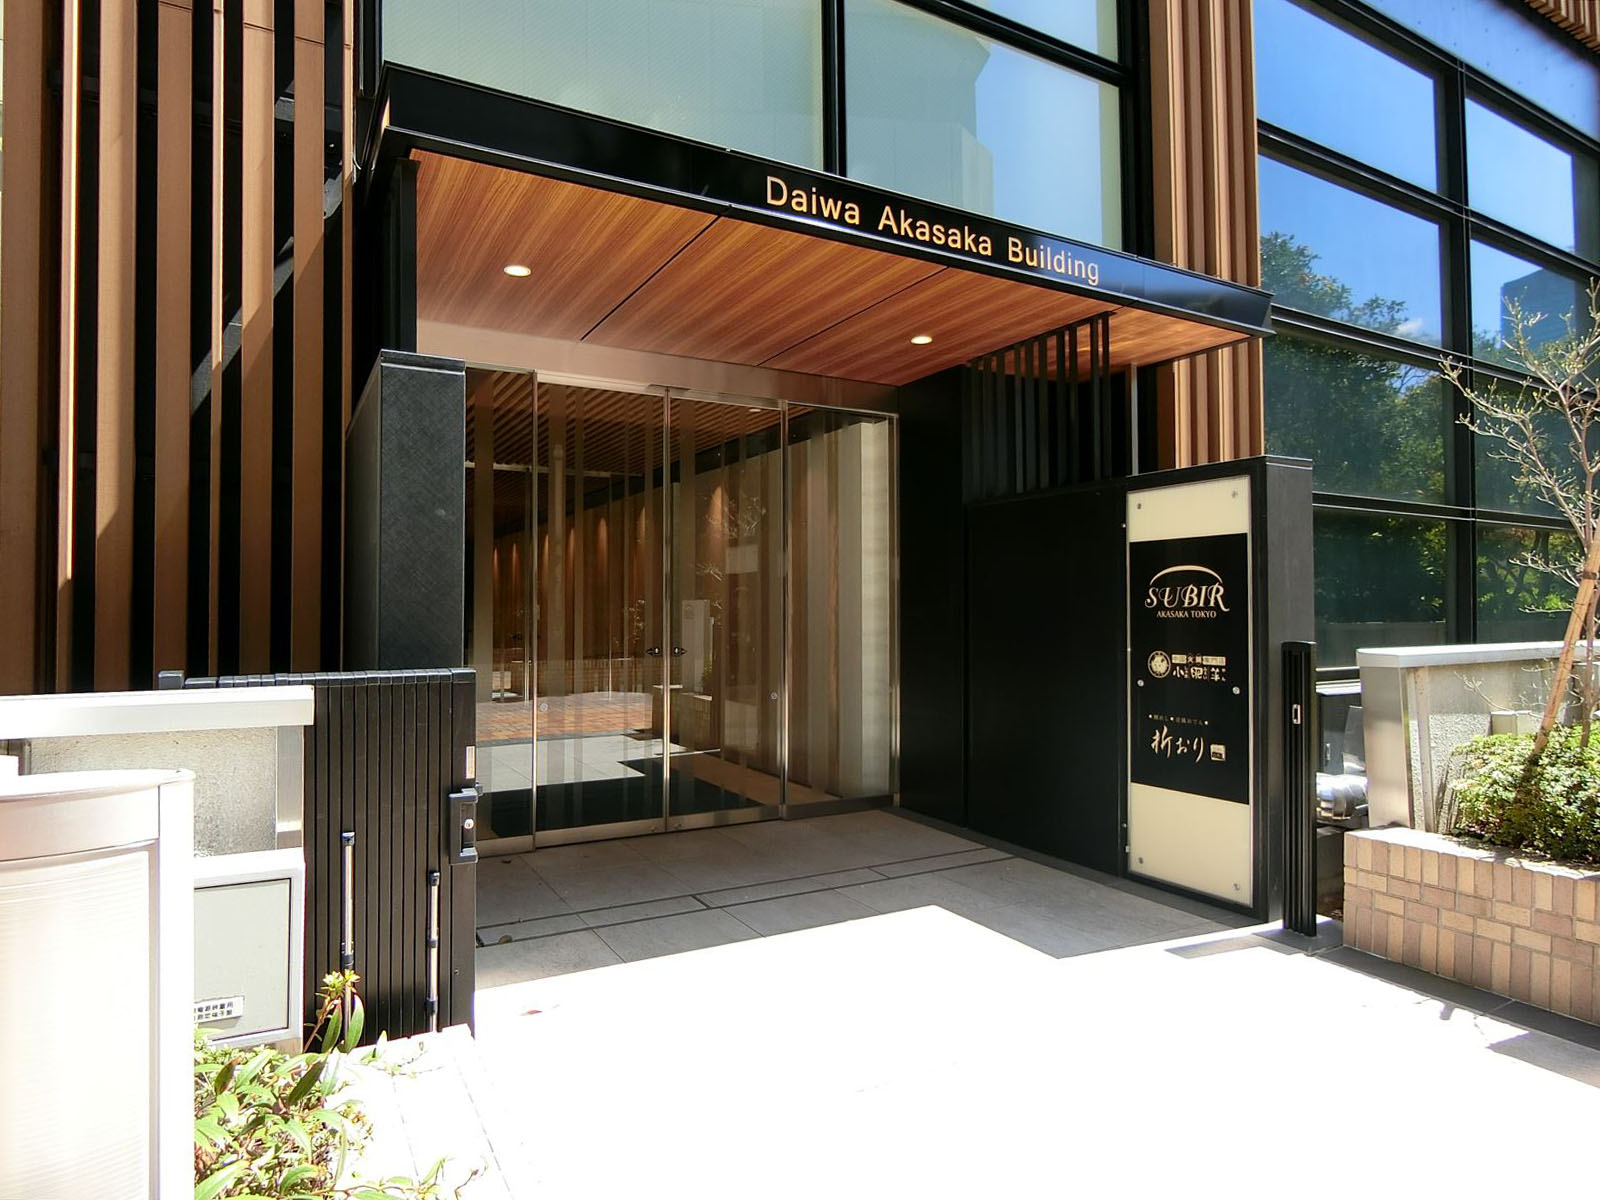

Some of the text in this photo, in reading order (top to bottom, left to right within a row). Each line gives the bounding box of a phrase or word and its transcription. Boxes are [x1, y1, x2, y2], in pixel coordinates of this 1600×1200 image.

[766, 175, 1100, 286] Daiwa Akasaka Building
[1144, 582, 1230, 612] SUBIR
[1156, 610, 1217, 619] AKASAKA TOKYO
